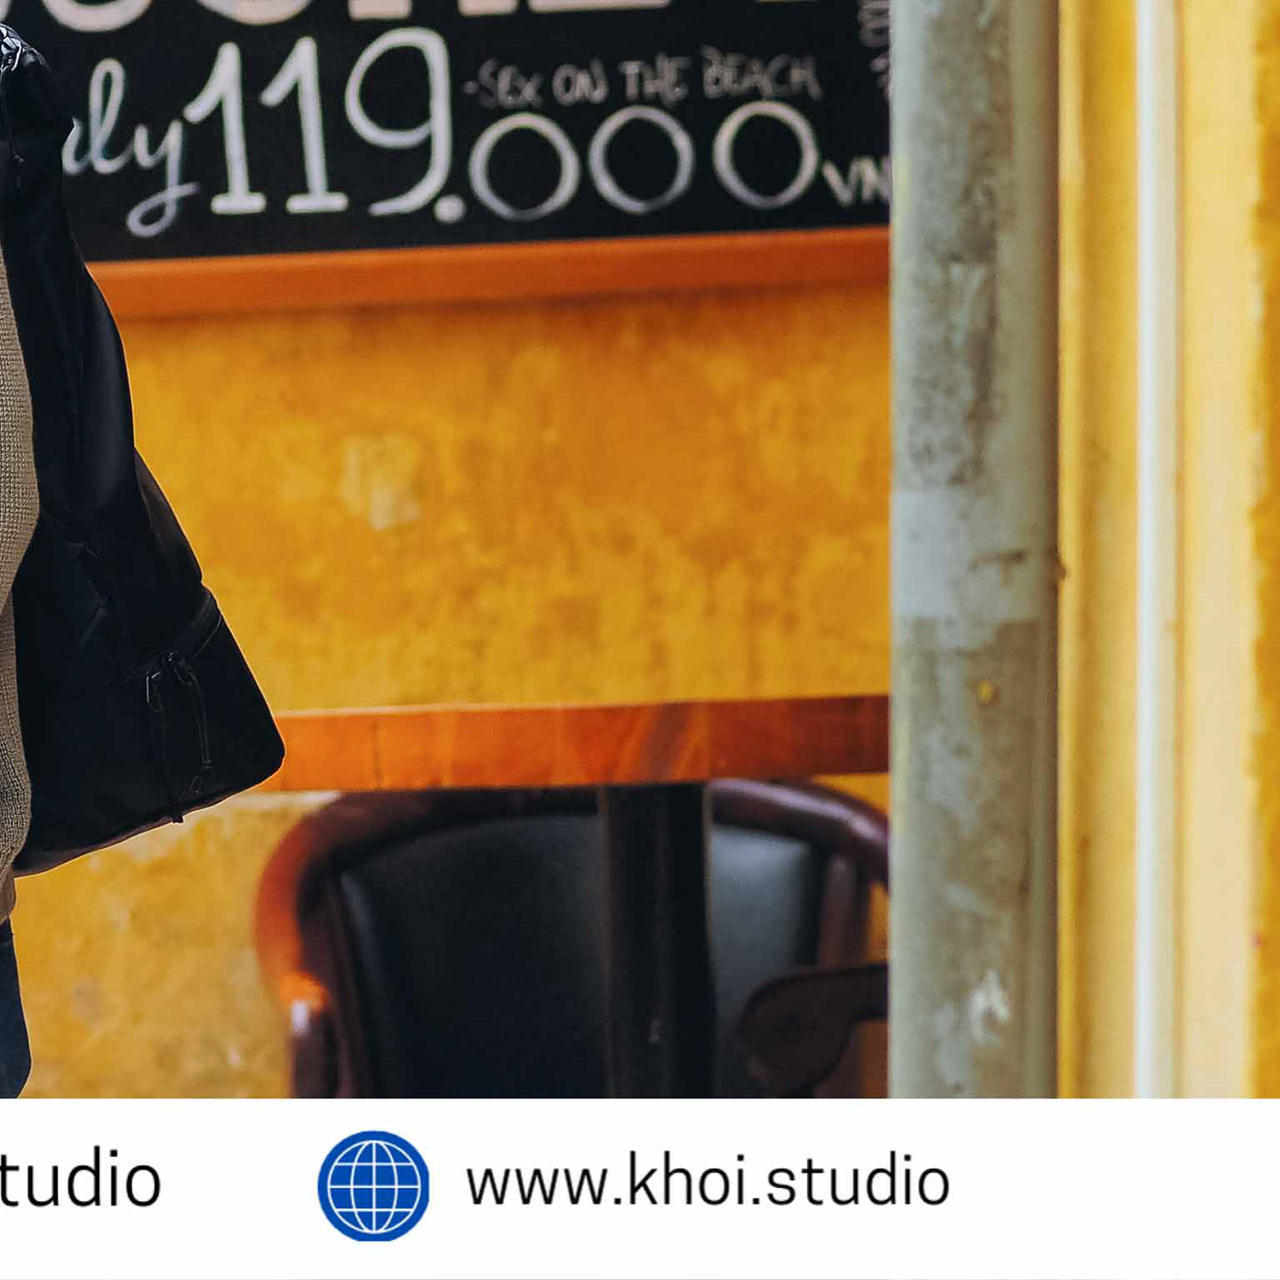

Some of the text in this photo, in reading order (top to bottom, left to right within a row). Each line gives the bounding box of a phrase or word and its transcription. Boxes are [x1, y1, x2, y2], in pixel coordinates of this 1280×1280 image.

[552, 58, 609, 106] ON
[619, 52, 691, 108] THE
[701, 44, 824, 102] BEACH
